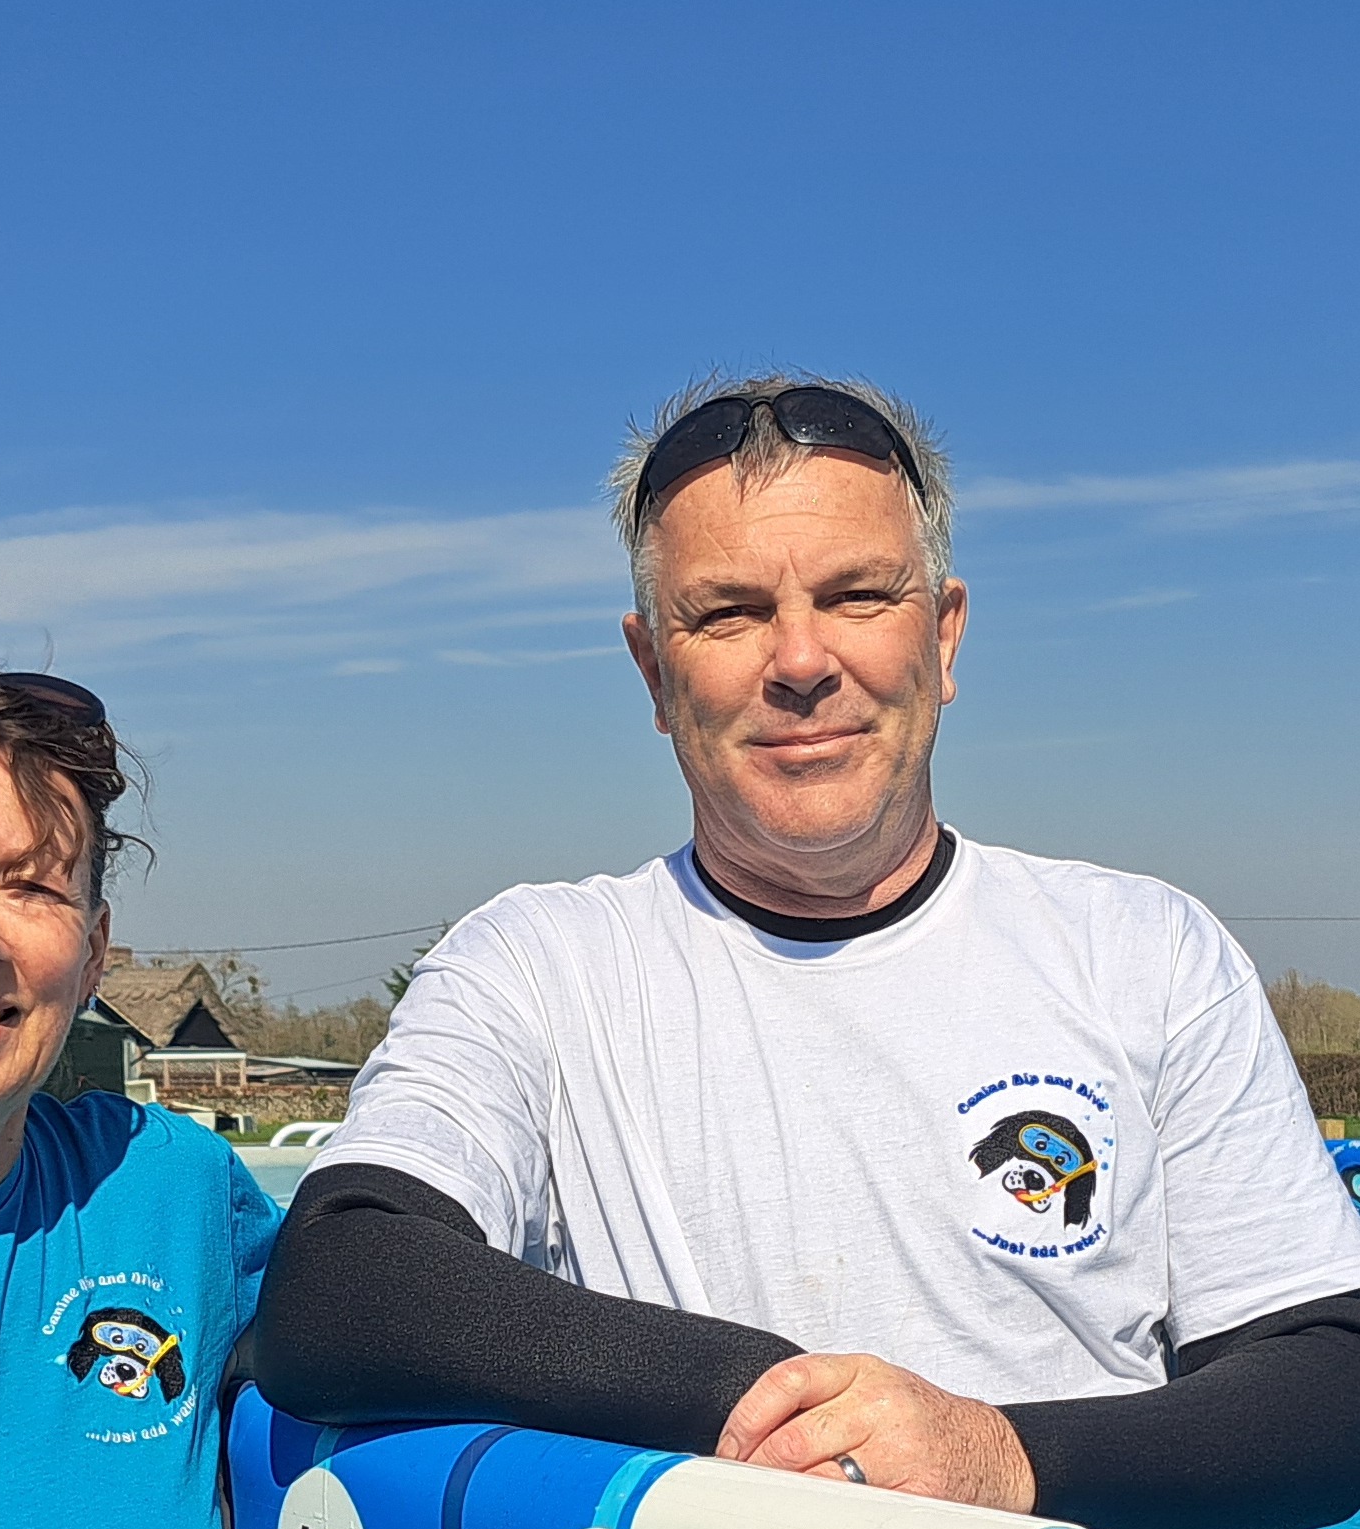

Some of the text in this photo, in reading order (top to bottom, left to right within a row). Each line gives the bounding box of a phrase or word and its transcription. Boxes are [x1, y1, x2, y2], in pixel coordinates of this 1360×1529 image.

[957, 1079, 1007, 1114] Canine
[1011, 1072, 1040, 1087] Dip
[1043, 1074, 1073, 1091] and
[1029, 1244, 1059, 1257] add
[41, 1287, 79, 1335] Canine
[98, 1271, 126, 1286] and
[141, 1421, 168, 1440] add
